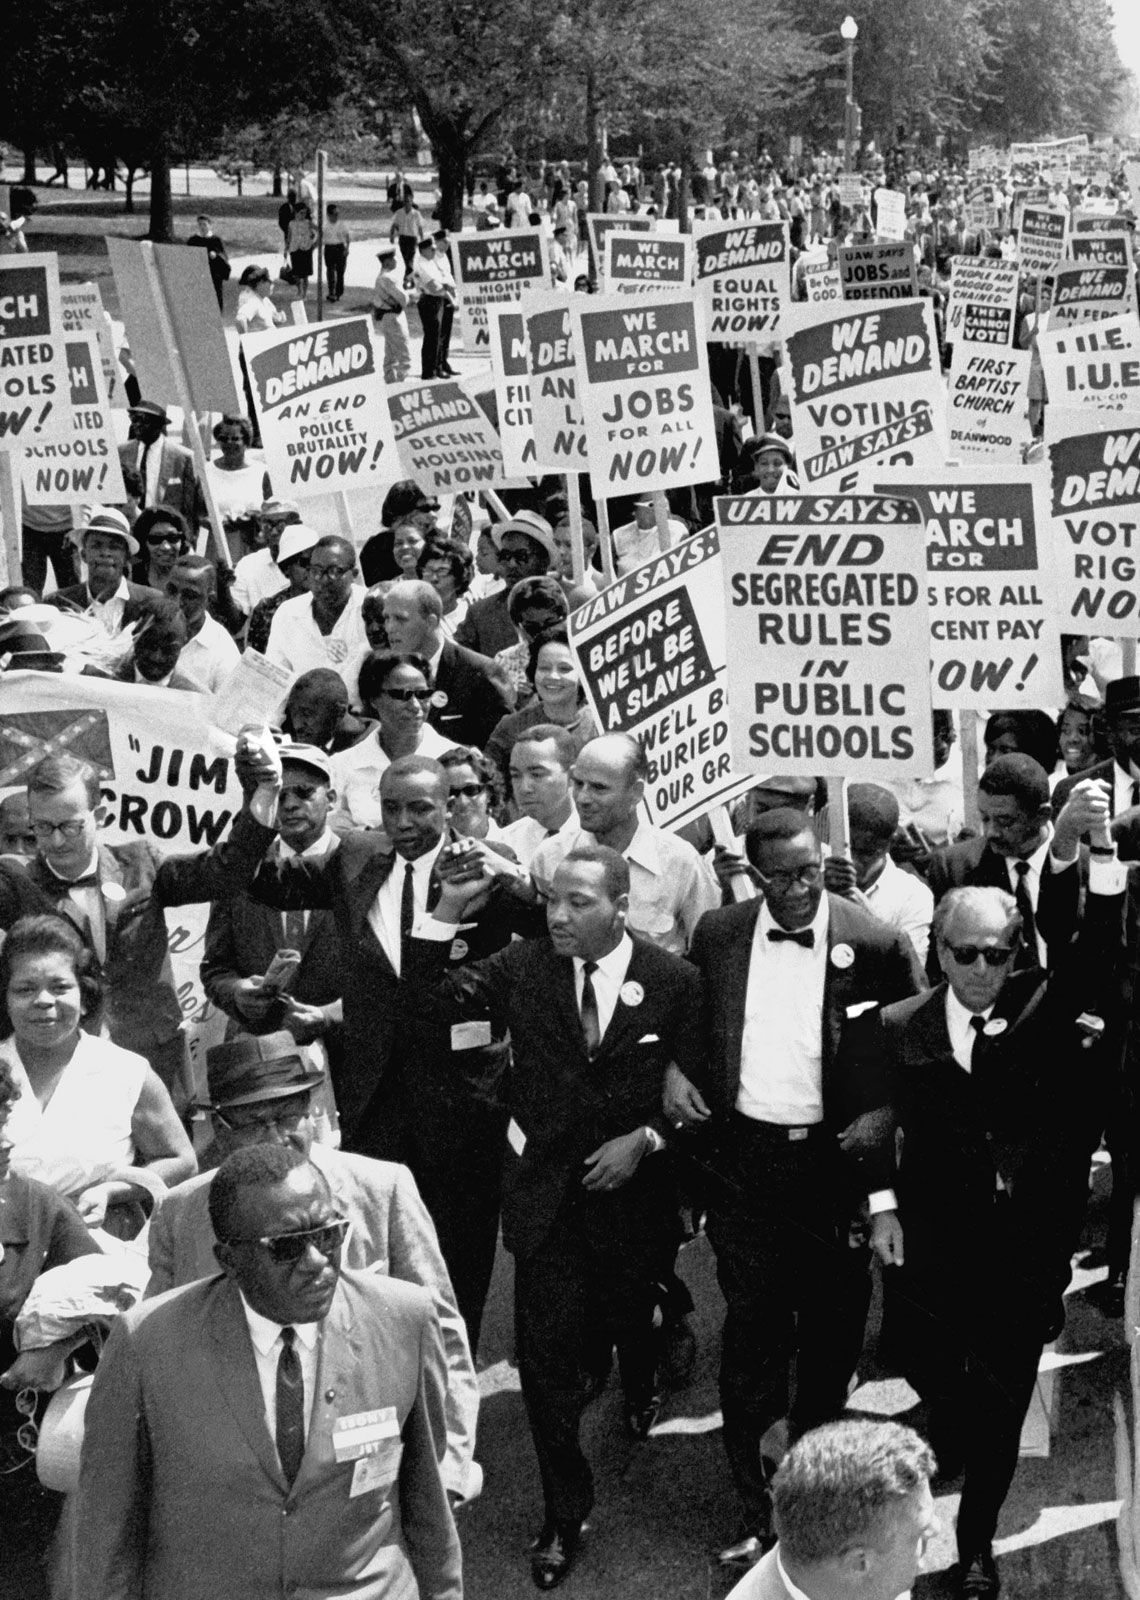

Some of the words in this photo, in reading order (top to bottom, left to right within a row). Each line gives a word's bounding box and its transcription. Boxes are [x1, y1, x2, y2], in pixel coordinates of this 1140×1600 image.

[1025, 219, 1061, 232] MARCH
[487, 240, 512, 253] WE
[637, 242, 660, 254] WE
[726, 228, 758, 249] WE
[1090, 241, 1107, 251] WE
[467, 251, 536, 271] MARCH
[616, 253, 679, 270] MARCH
[704, 240, 783, 273] DEMAND
[845, 251, 873, 261] UAW
[1020, 246, 1061, 260] SCHOOLS
[489, 269, 516, 279] FOR
[636, 269, 660, 278] FOR
[844, 264, 889, 283] JOBS
[955, 268, 992, 280] PEOPLE
[1022, 258, 1058, 272] NOW!
[1080, 269, 1107, 284] WE
[480, 280, 532, 293] HIGHER
[713, 279, 777, 294] EQUAL
[1058, 282, 1123, 302] DEMAND
[711, 297, 780, 312] RIGHTS
[971, 306, 1005, 318] THEY
[1056, 307, 1079, 319] AN
[622, 311, 657, 332] WE
[711, 313, 781, 332] NOW!
[831, 314, 882, 351] WE
[965, 316, 1009, 330] CANNOT
[594, 329, 690, 363] MARCH
[965, 327, 1007, 343] VOTE
[0, 343, 54, 367] ATED
[288, 331, 330, 366] WE
[265, 343, 368, 404] DEMAND
[626, 359, 664, 376] FOR
[802, 334, 926, 395] DEMAND
[967, 356, 1017, 376] FIRST
[4, 373, 56, 397] OLS
[541, 376, 576, 399] AN
[954, 374, 1021, 396] BAPTIST
[278, 402, 310, 421] AN
[319, 394, 366, 414] END
[399, 388, 435, 412] WE
[602, 384, 695, 424] JOBS
[953, 393, 1015, 414] CHURCH
[393, 399, 471, 436] DEMAND
[565, 404, 585, 426] L
[300, 418, 354, 439] POLICE
[607, 426, 649, 442] FOR
[660, 420, 694, 434] ALL
[950, 429, 1013, 446] DEANWOOD
[286, 431, 368, 457] BRUTALITY
[409, 432, 485, 450] DECENT
[810, 443, 855, 478] UAW
[860, 411, 926, 457] SAYS:
[1103, 431, 1140, 467] W
[290, 439, 384, 484] NOW!
[608, 436, 703, 482] NOW!
[36, 462, 108, 492] NOW!
[434, 464, 495, 487] NOW
[1060, 466, 1140, 507] DEM
[727, 499, 802, 523] UAW
[809, 499, 912, 523] SAYS:
[928, 491, 977, 514] WE
[926, 517, 1024, 547] ARCH
[1064, 519, 1137, 548] VOT
[757, 534, 885, 567] END
[931, 552, 984, 567] FOR
[1074, 553, 1136, 582] RIG
[575, 581, 627, 630] UAW
[634, 530, 716, 595] SAYS:
[731, 572, 919, 607] SEGREGATED
[944, 585, 992, 607] FOR
[1000, 585, 1044, 606] ALL
[1070, 586, 1140, 619] NO
[590, 598, 682, 673] BEFORE
[758, 612, 892, 646] RULES
[930, 619, 990, 641] CENT
[997, 618, 1045, 641] PAY
[664, 624, 695, 662] BE
[800, 660, 850, 678] IN
[929, 652, 1039, 692] OW!
[608, 701, 622, 730] A
[626, 656, 706, 717] SLAVE,
[754, 683, 906, 717] PUBLIC
[638, 703, 697, 750] WE'LL
[647, 720, 728, 785] BURIED
[748, 723, 914, 760] SCHOOLS
[656, 772, 695, 812] OUR
[702, 752, 731, 784] GR
